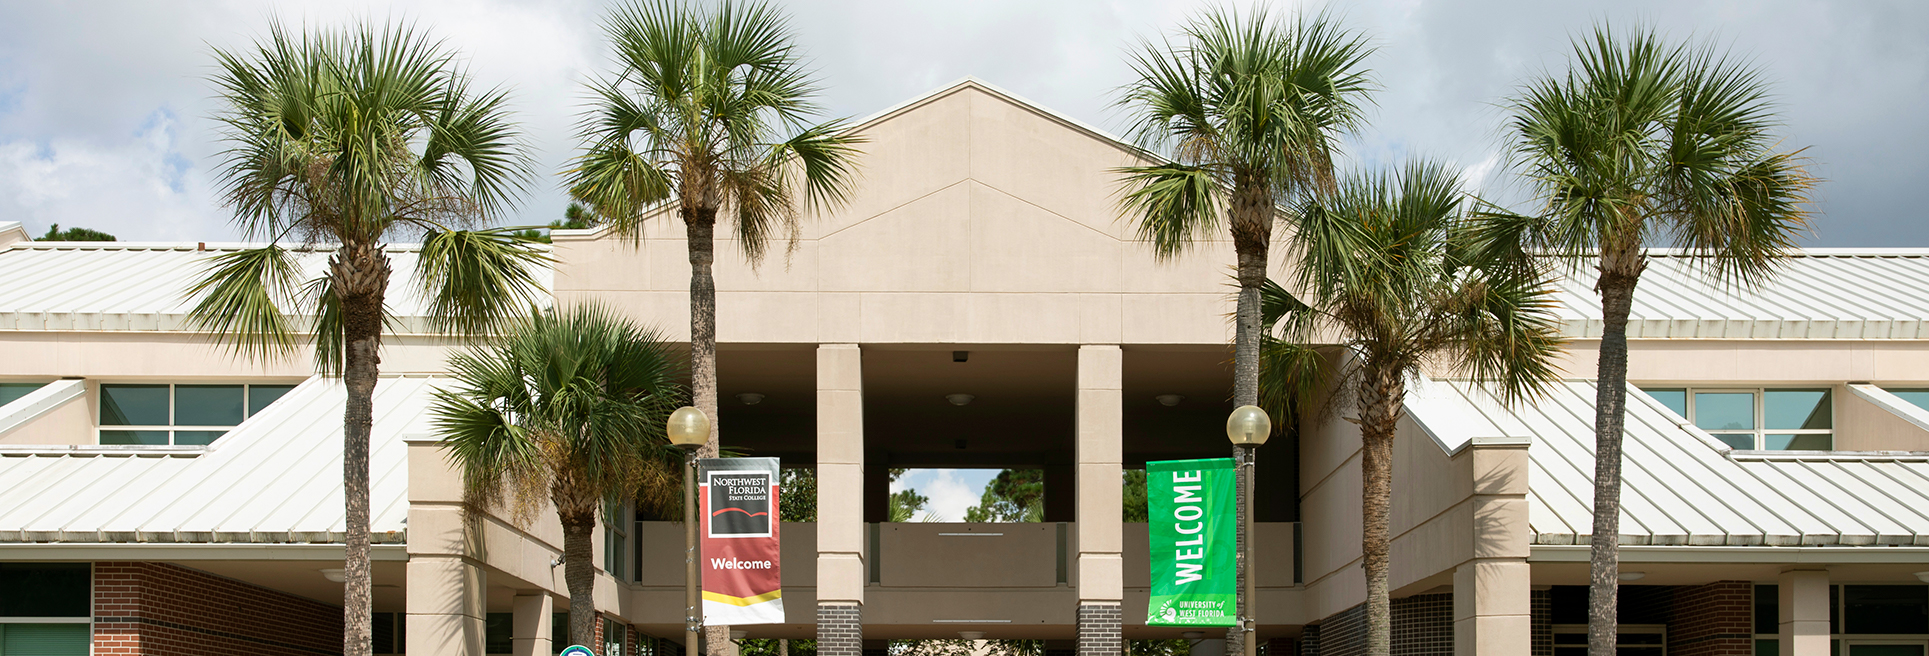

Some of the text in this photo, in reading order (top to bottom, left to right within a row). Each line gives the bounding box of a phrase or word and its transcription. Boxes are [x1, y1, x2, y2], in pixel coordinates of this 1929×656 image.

[713, 477, 767, 486] NORTHWEST
[728, 486, 767, 495] FLORIDA
[1173, 470, 1203, 586] WELCOME
[710, 557, 772, 570] Welcome
[1216, 600, 1225, 609] of
[1179, 609, 1196, 617] WEST
